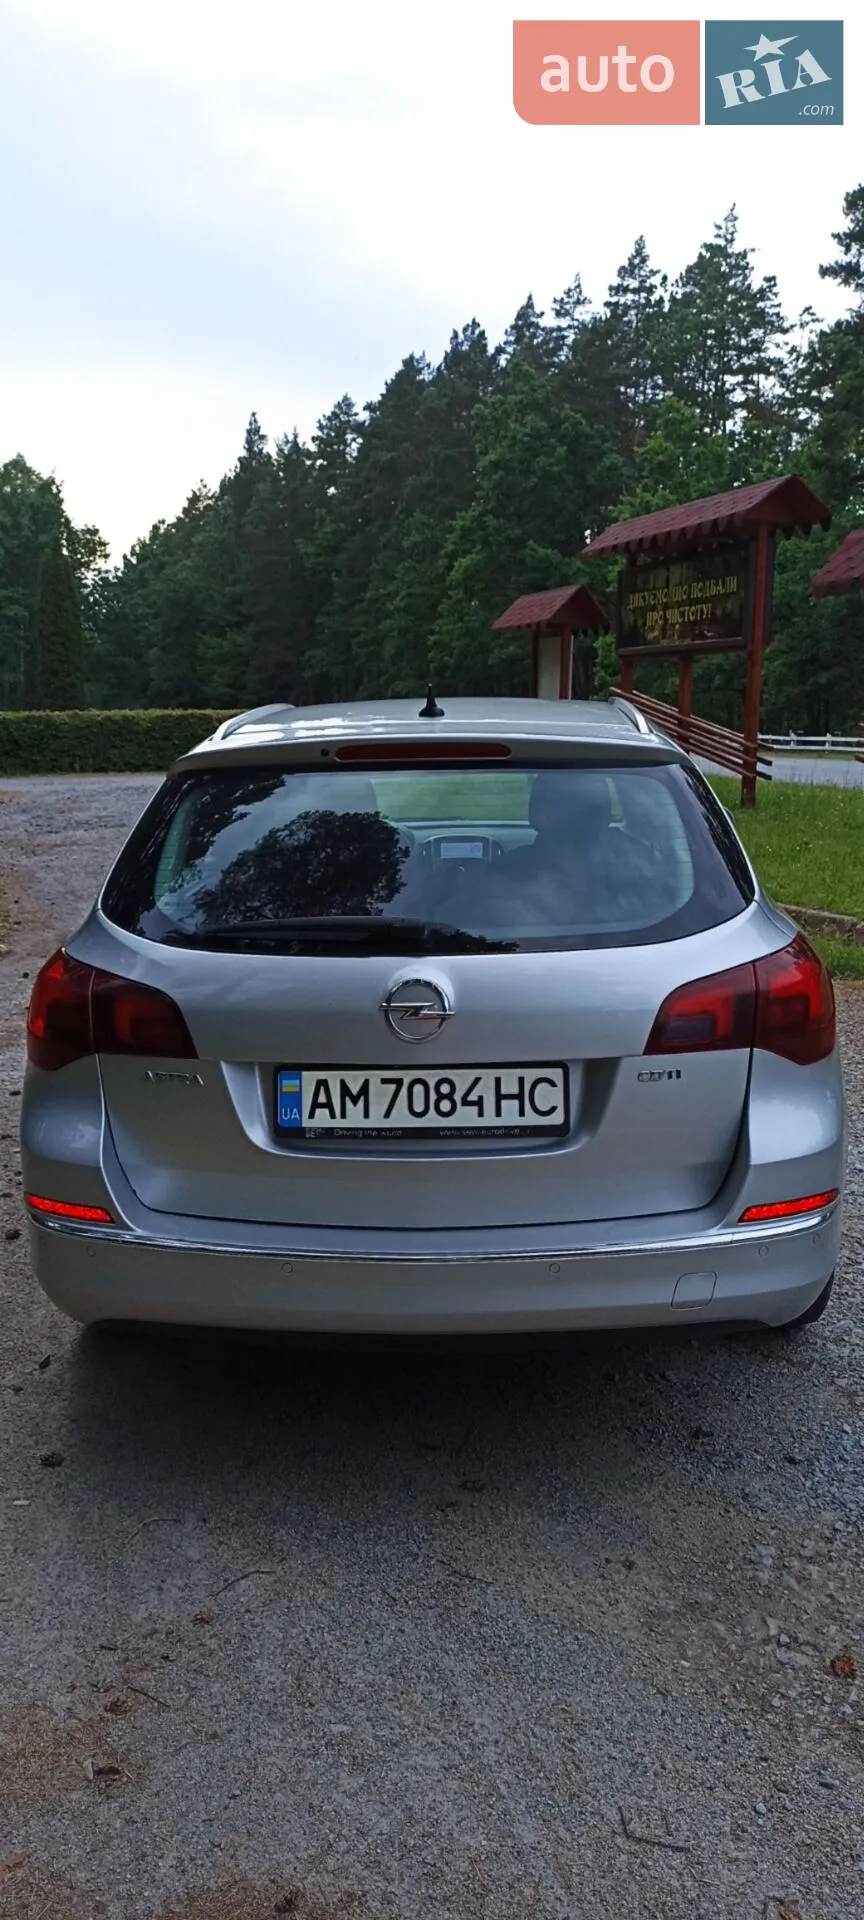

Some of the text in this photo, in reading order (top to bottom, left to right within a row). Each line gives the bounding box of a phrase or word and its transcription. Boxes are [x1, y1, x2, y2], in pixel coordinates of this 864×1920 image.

[690, 576, 737, 597] ПОДБАЛИ
[646, 604, 712, 626] ПРО ЧИСТОТУ!
[380, 1076, 484, 1119] 7084
[281, 1107, 300, 1121] UA
